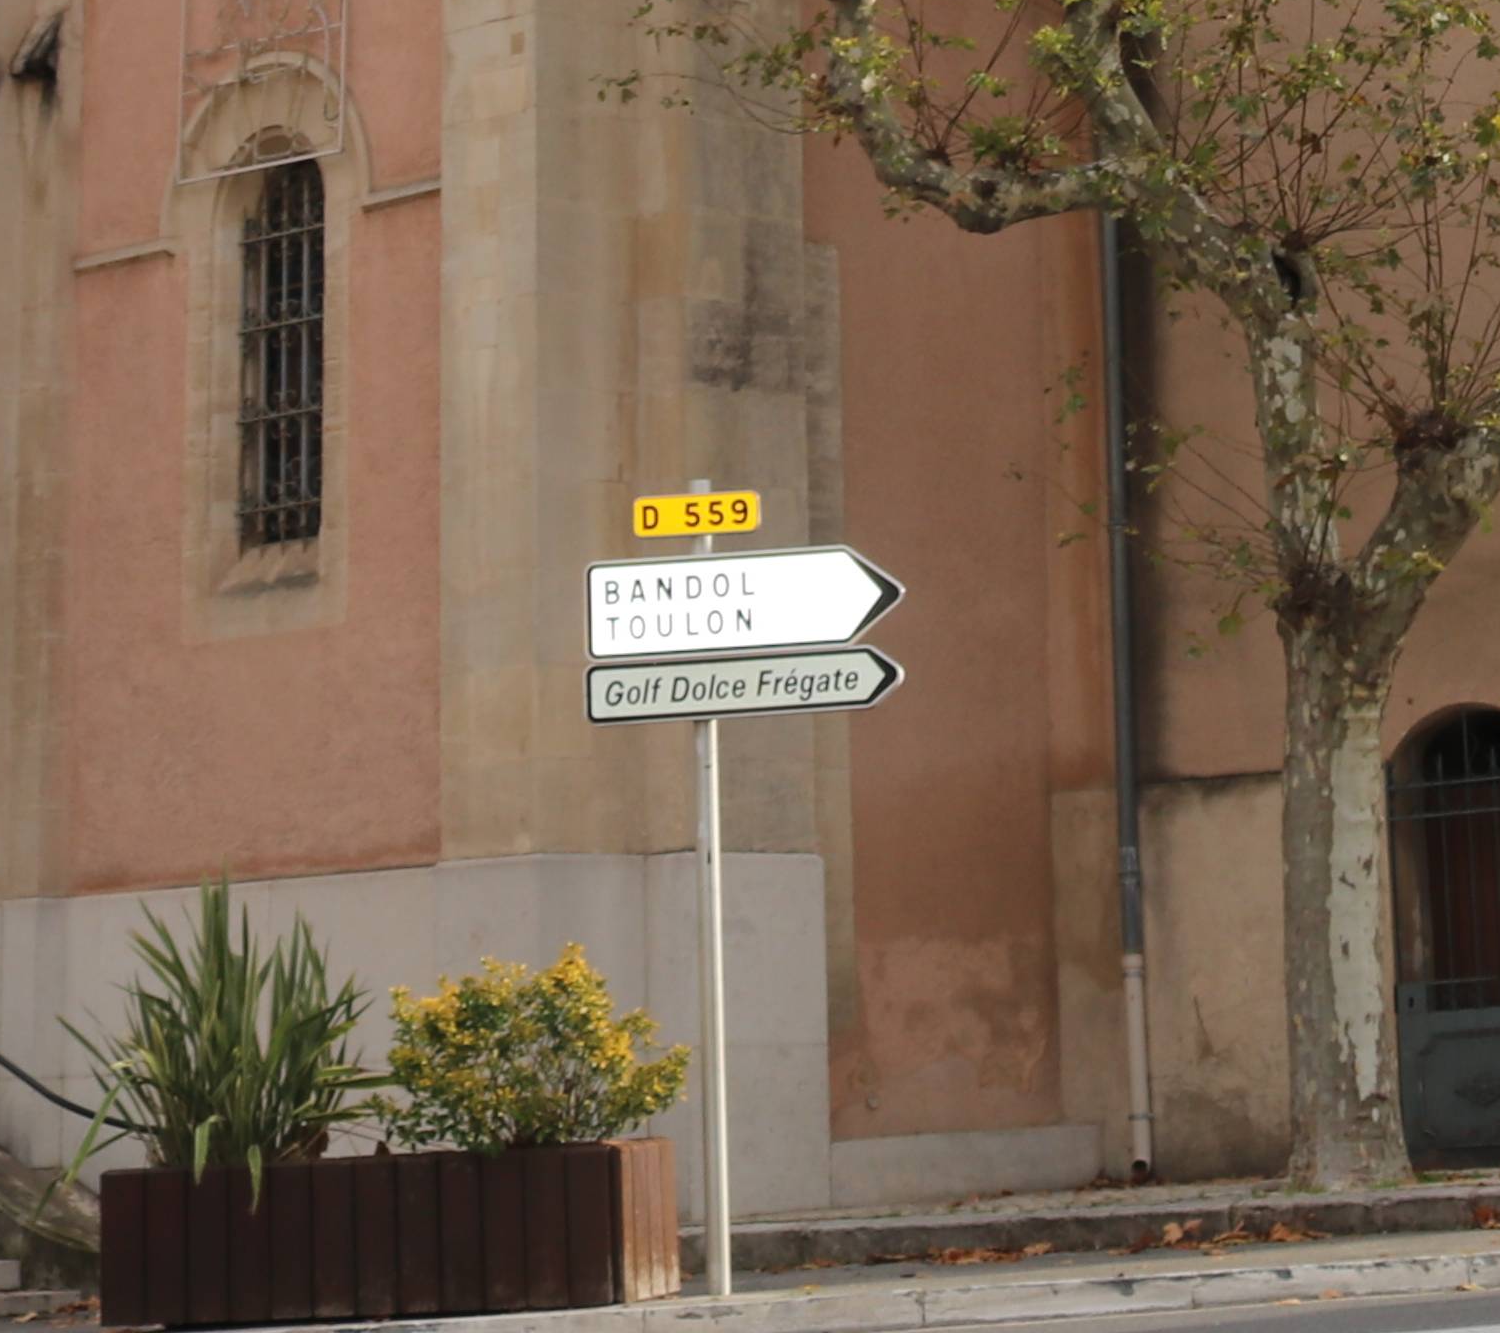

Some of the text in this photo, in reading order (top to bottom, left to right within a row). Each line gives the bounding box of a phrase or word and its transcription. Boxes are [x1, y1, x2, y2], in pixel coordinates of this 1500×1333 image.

[642, 499, 749, 530] D 559
[605, 572, 755, 605] BANDOL
[606, 609, 752, 640] TOULON
[605, 668, 860, 707] Golf Dolce Frégate
